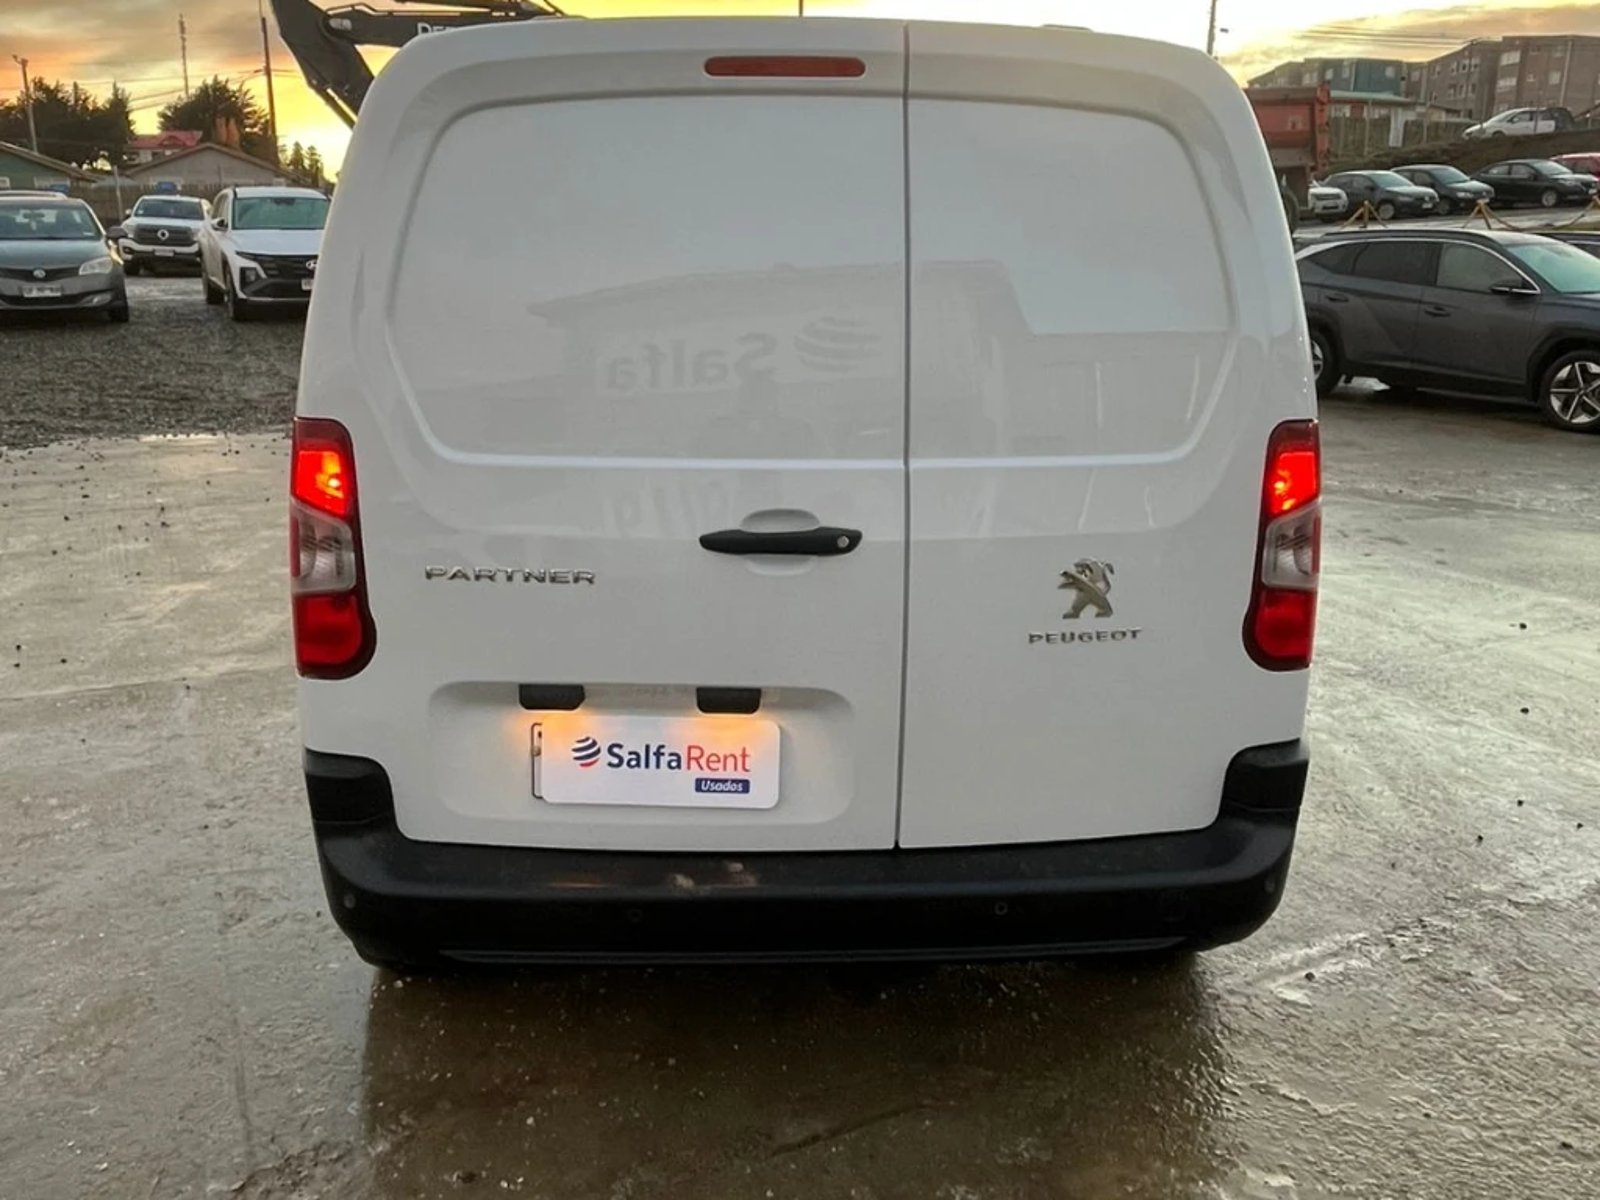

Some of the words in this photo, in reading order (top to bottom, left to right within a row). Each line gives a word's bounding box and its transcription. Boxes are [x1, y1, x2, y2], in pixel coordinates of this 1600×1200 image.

[425, 565, 596, 584] PARTNER
[1028, 627, 1143, 644] PEUGEOT
[606, 743, 751, 772] SalfaRent
[701, 780, 743, 792] Usados
